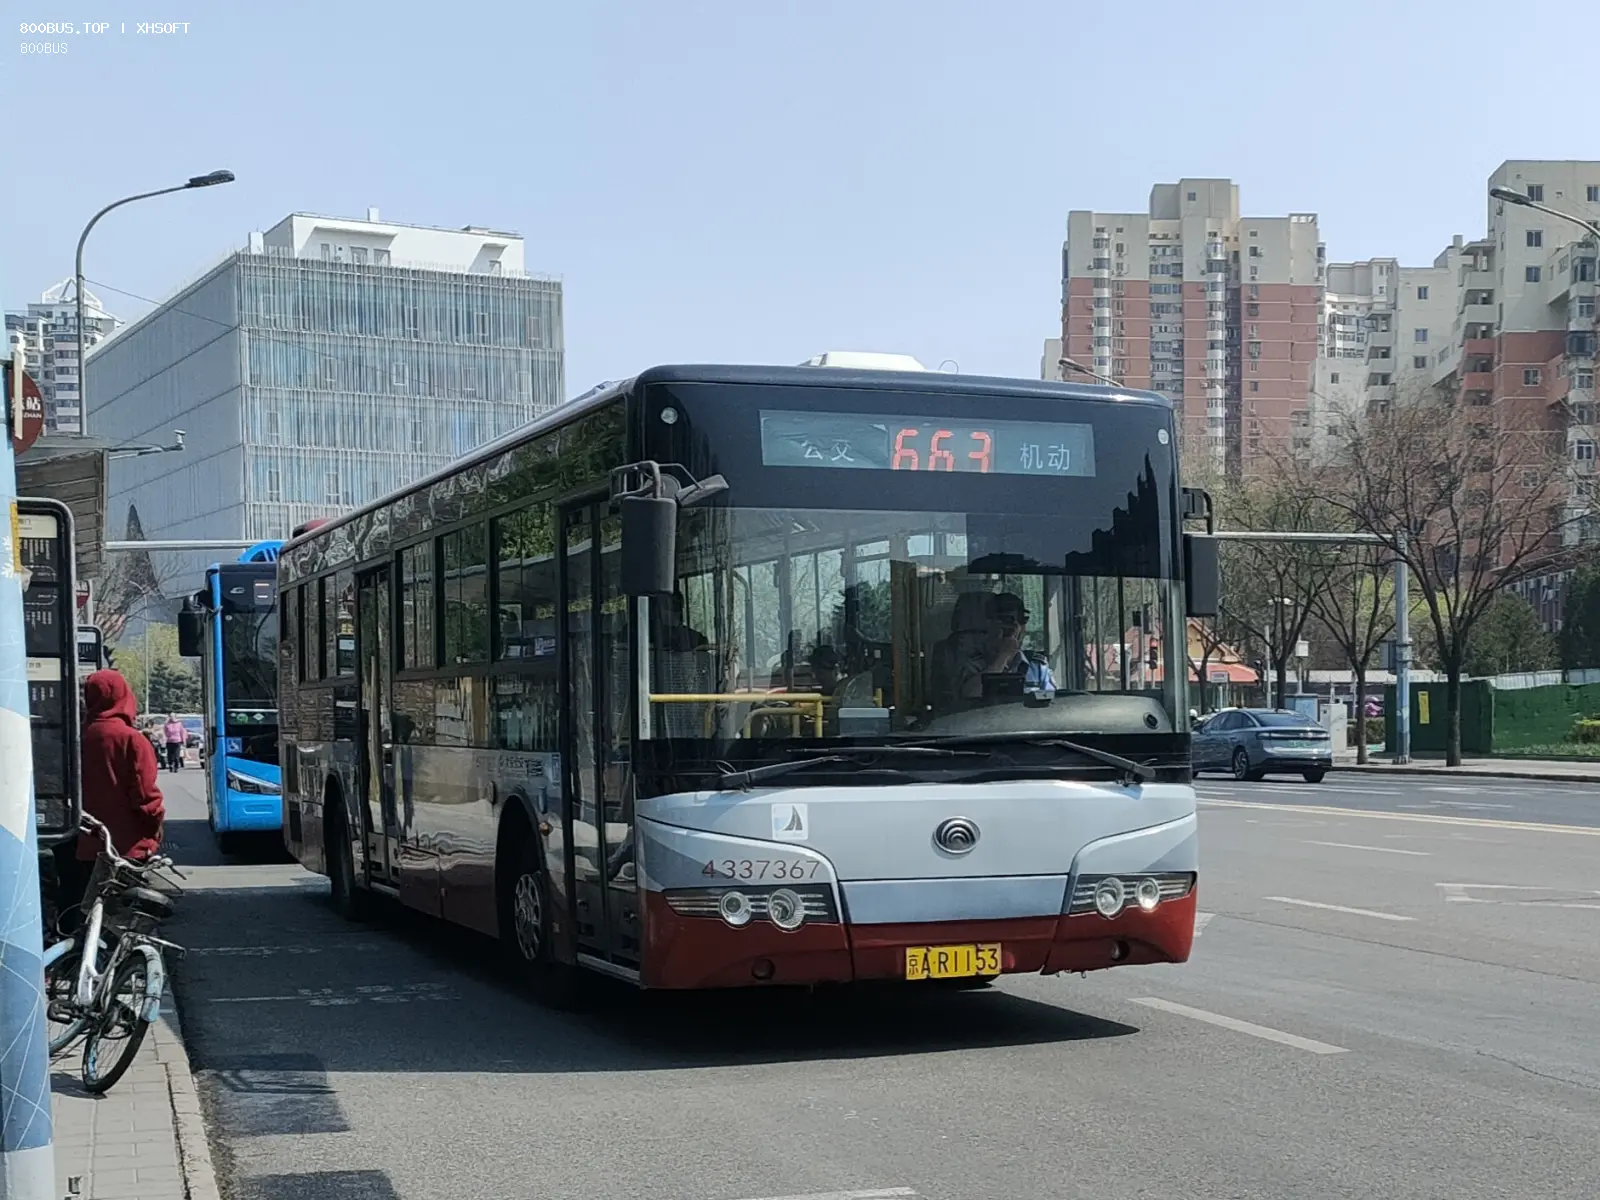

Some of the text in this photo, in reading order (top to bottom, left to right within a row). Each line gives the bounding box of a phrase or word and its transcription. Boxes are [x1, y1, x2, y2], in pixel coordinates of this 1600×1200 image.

[892, 429, 993, 473] 663
[1020, 442, 1070, 471] 机动
[702, 859, 821, 880] 4337367
